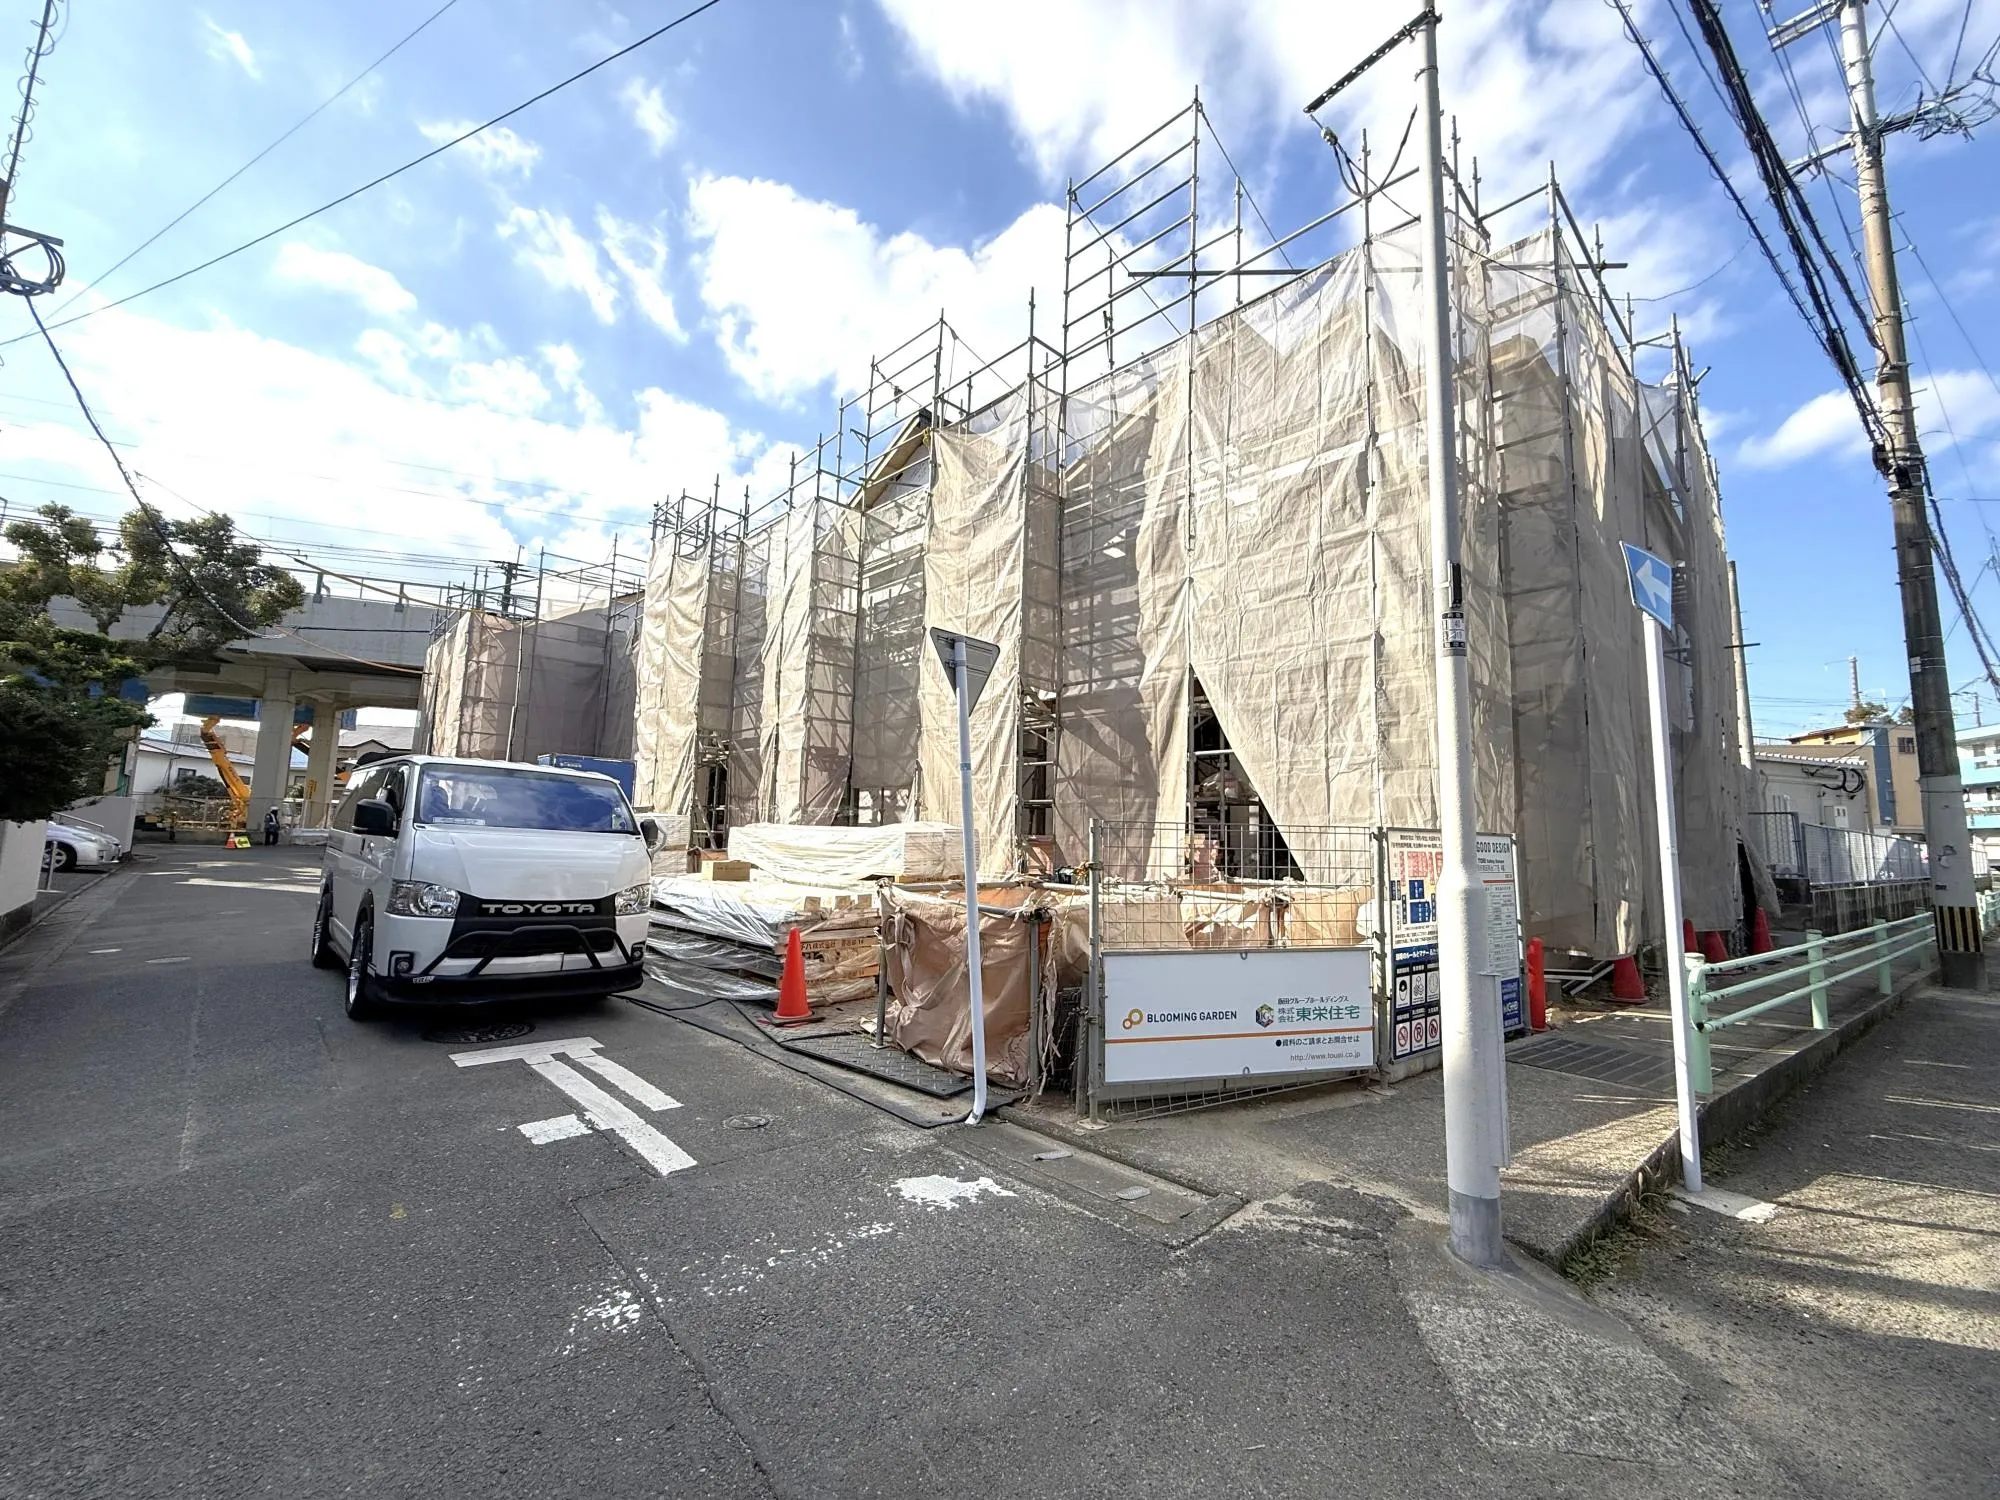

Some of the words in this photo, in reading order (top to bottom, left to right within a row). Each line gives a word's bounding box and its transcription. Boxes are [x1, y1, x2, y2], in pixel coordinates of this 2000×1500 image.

[1476, 842, 1491, 853] GOOD
[1492, 842, 1510, 854] DESIGN
[482, 903, 595, 914] TOYOTA
[1147, 1012, 1197, 1024] BLOOMING
[1199, 1010, 1237, 1021] GARDEN
[1295, 1005, 1360, 1021] 東栄住宅
